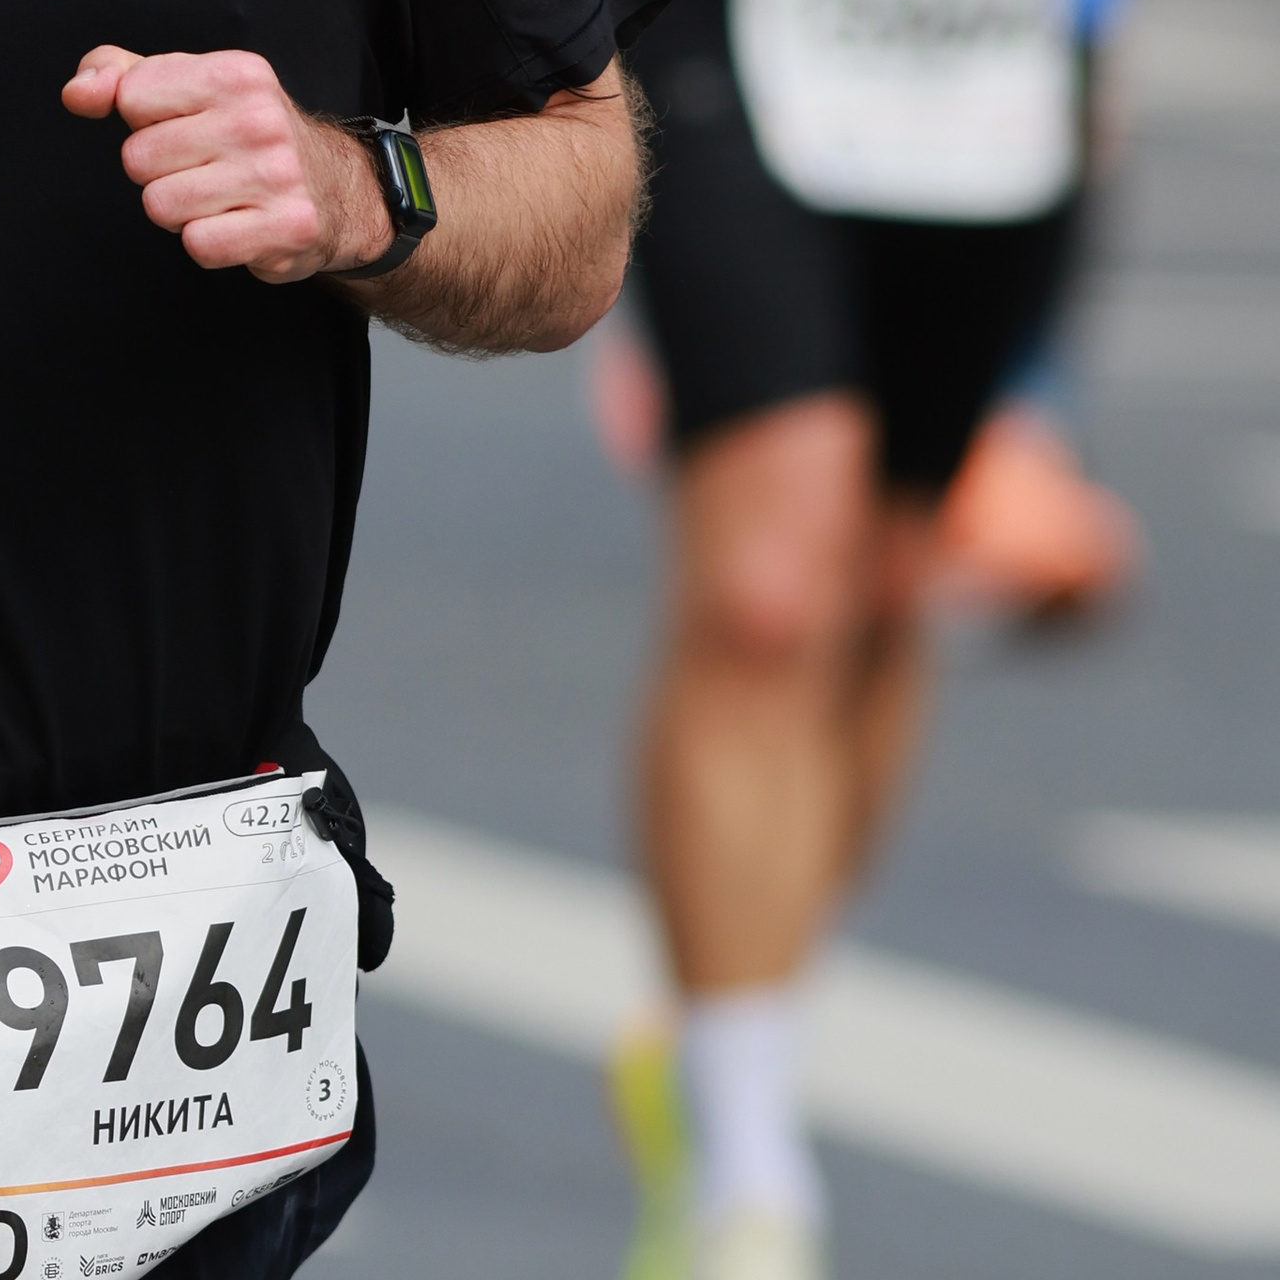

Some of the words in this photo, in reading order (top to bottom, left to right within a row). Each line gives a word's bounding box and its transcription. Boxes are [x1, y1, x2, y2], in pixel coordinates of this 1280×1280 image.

[24, 817, 158, 846] СБЕРПРАЙМ
[28, 824, 211, 869] МОСКОВСКИЙ
[33, 857, 168, 893] МАРАФОН
[319, 1078, 331, 1102] 3
[93, 1091, 234, 1145] НИКИТА
[160, 1187, 217, 1210] МОСКОВСКИЙ
[69, 1208, 112, 1219] Департамент
[69, 1219, 91, 1229] спорта
[160, 1209, 186, 1226] СПОРТ
[69, 1229, 91, 1238] города
[93, 1226, 119, 1234] Москвы
[95, 1261, 124, 1276] BRICS
